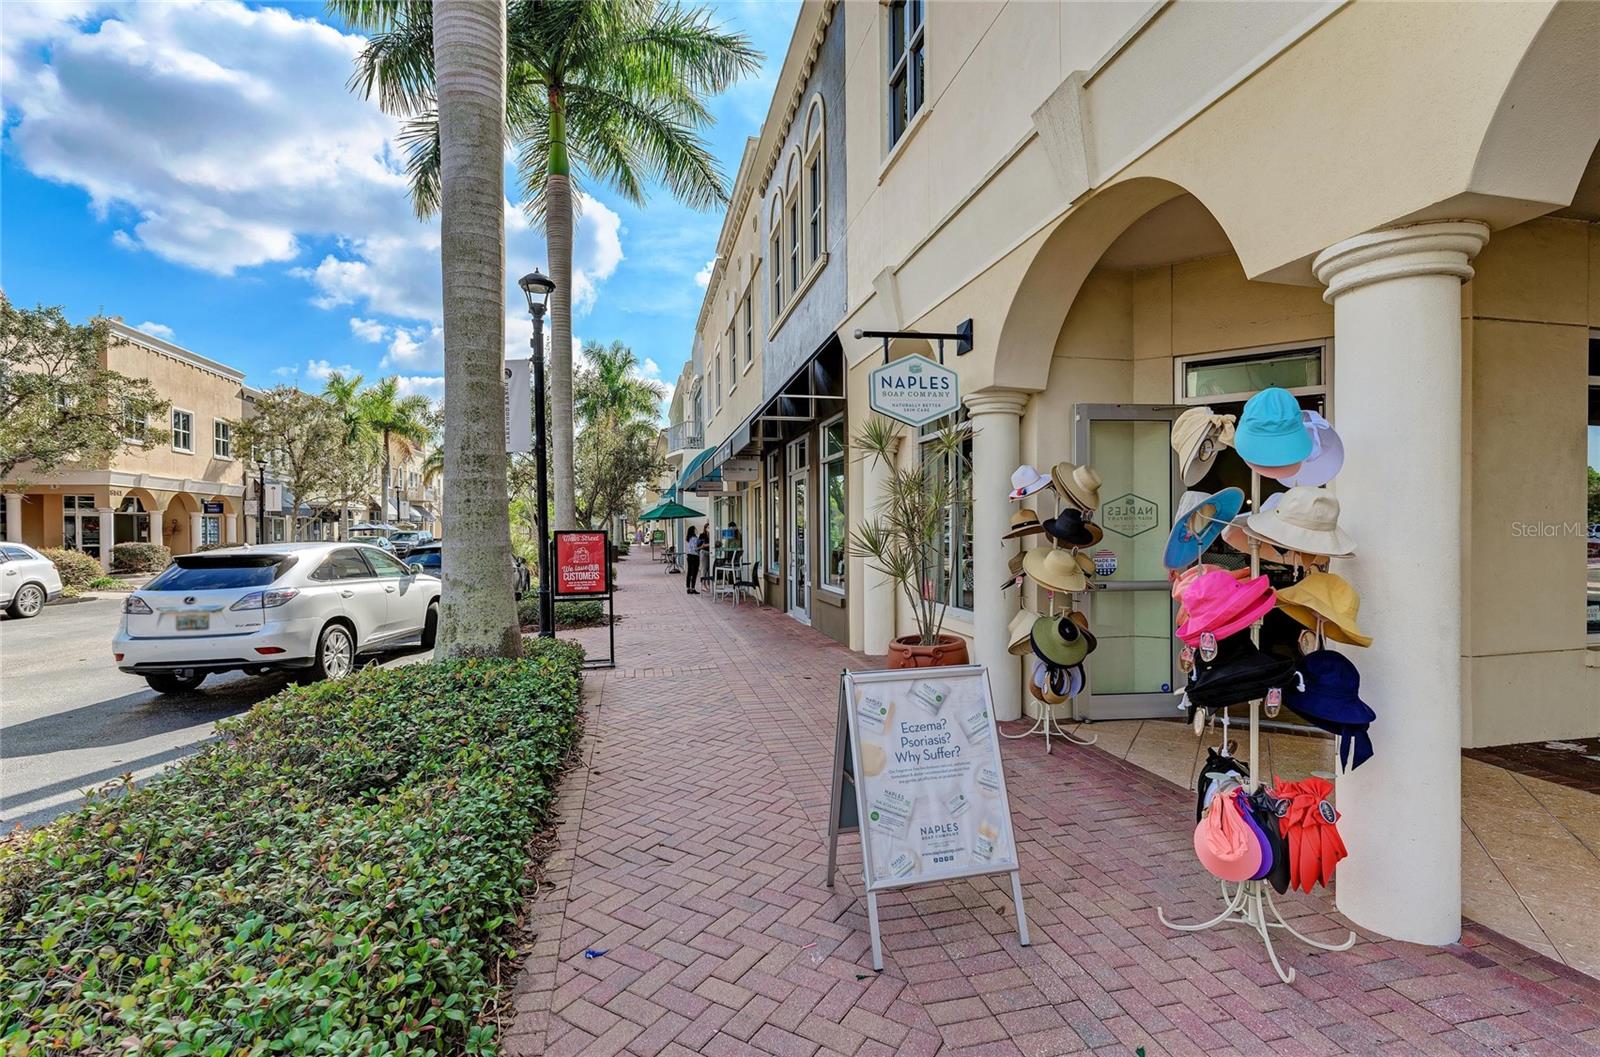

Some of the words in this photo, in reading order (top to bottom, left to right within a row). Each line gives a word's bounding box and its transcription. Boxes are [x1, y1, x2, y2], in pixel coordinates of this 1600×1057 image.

[881, 376, 950, 390] NAPLES
[588, 564, 600, 572] OUR
[563, 571, 600, 581] CUSTOMERS
[900, 718, 947, 734] Eczema?
[900, 732, 951, 749] Psoriasis?
[894, 750, 922, 765] Why
[923, 745, 961, 762] Suffer?
[920, 822, 959, 837] NAPLES
